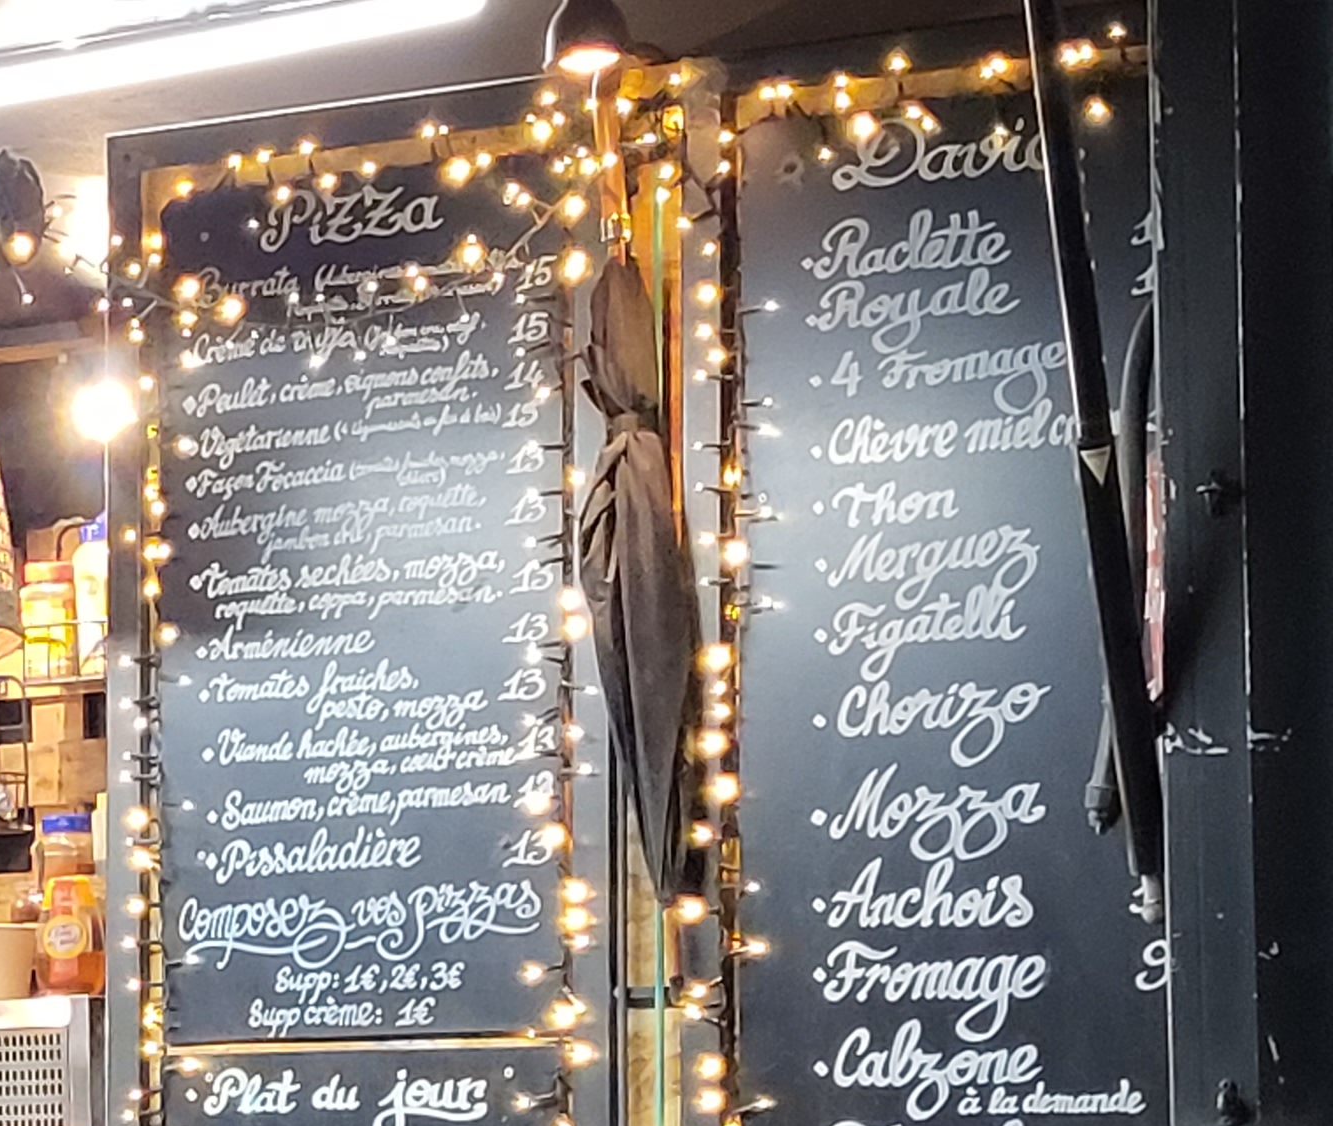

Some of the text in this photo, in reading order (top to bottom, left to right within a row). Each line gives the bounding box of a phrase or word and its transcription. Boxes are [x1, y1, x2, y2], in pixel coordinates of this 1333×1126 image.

[812, 207, 1012, 280] Raclette
[515, 255, 557, 292] 15
[507, 311, 549, 344] 15
[815, 267, 1022, 355] Royale
[504, 360, 544, 391] 14
[831, 351, 863, 397] 4
[827, 415, 958, 466] Chèvre
[964, 398, 1053, 455] miel
[256, 459, 346, 493] Focaccia
[200, 504, 307, 545] Aubergine
[398, 484, 487, 520] roquette,
[832, 480, 959, 528] Thon
[370, 515, 482, 555] parmesan.
[404, 550, 505, 587] mozza,
[827, 524, 1042, 611] Merguez
[369, 584, 503, 620] parmesan.
[207, 612, 550, 661] Arménienne 13
[827, 588, 1027, 682] Figatelli
[209, 673, 309, 704] Tomates
[498, 668, 547, 701] 13
[315, 688, 489, 729] pesto, mozza
[218, 729, 294, 767] Viande
[379, 723, 509, 757] aubergines,
[837, 680, 1052, 768] Chorizo
[304, 758, 396, 794] mozza,
[221, 781, 512, 830] Saumon, crème, parmesan
[829, 763, 1046, 861] Mozza
[216, 827, 555, 885] Pissaladière 13
[352, 895, 408, 930] vos
[827, 856, 1035, 929] Anchois
[823, 938, 1171, 1043] Fromage 9
[248, 998, 300, 1038] Supp
[394, 996, 436, 1027] 1€
[203, 1067, 301, 1117] Plat
[311, 1075, 361, 1112] du
[833, 1018, 1044, 1121] Calzone
[957, 1079, 1147, 1116] à la demande
